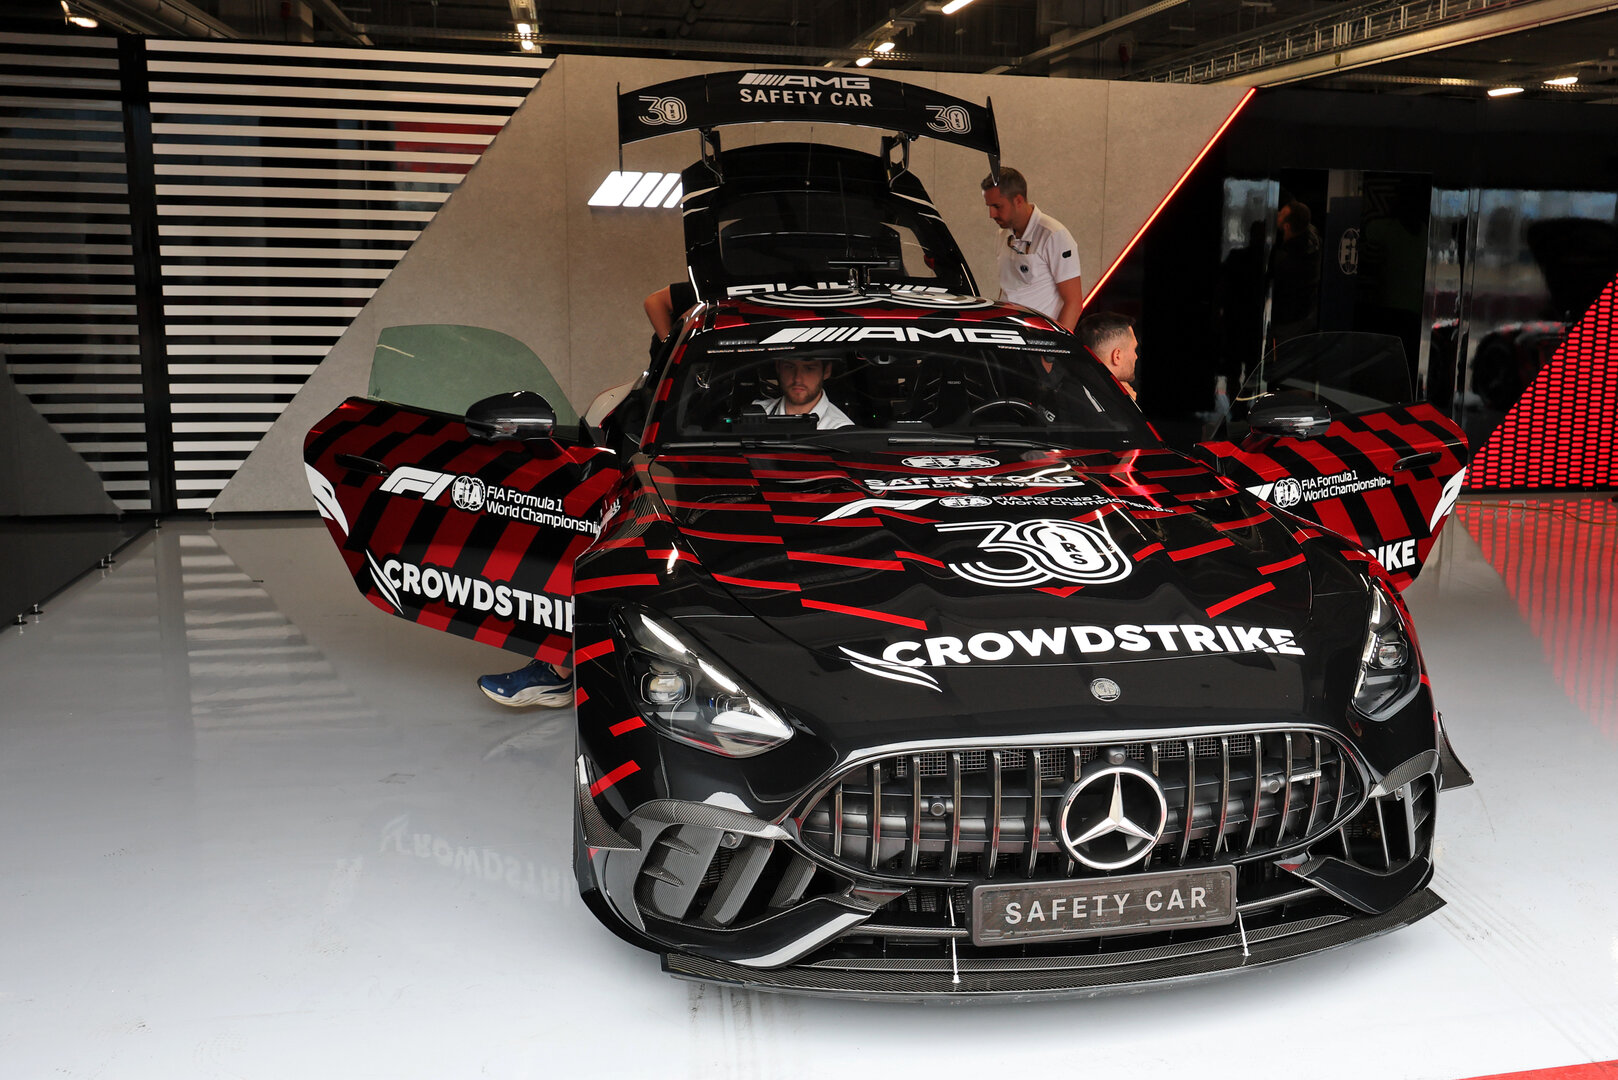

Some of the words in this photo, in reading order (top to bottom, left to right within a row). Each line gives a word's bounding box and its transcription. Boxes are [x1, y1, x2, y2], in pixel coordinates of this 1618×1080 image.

[778, 75, 870, 89] AMG
[740, 88, 822, 104] SAFETY
[830, 92, 873, 107] CAR
[638, 95, 688, 126] 30
[925, 105, 972, 135] 30
[848, 326, 1027, 345] AMG
[905, 456, 993, 468] FIA
[380, 465, 457, 502] F1
[454, 480, 483, 504] FIA
[864, 475, 994, 487] SAFETY
[1006, 475, 1079, 484] CAR
[1275, 480, 1300, 503] FIA
[1301, 479, 1317, 491] FIA
[1317, 471, 1352, 486] Formula
[1352, 470, 1358, 480] 1
[486, 485, 506, 501] FIA
[506, 489, 555, 511] Formula
[555, 498, 564, 513] 1
[940, 496, 990, 507] FIA
[1302, 488, 1329, 502] World
[486, 500, 519, 518] World
[520, 507, 600, 534] Championshi
[934, 519, 1133, 587] 30
[1367, 538, 1416, 571] IKE
[881, 624, 1306, 668] CROWDSTRIKE
[1005, 893, 1130, 925] SAFETY
[1145, 887, 1207, 912] CAR
